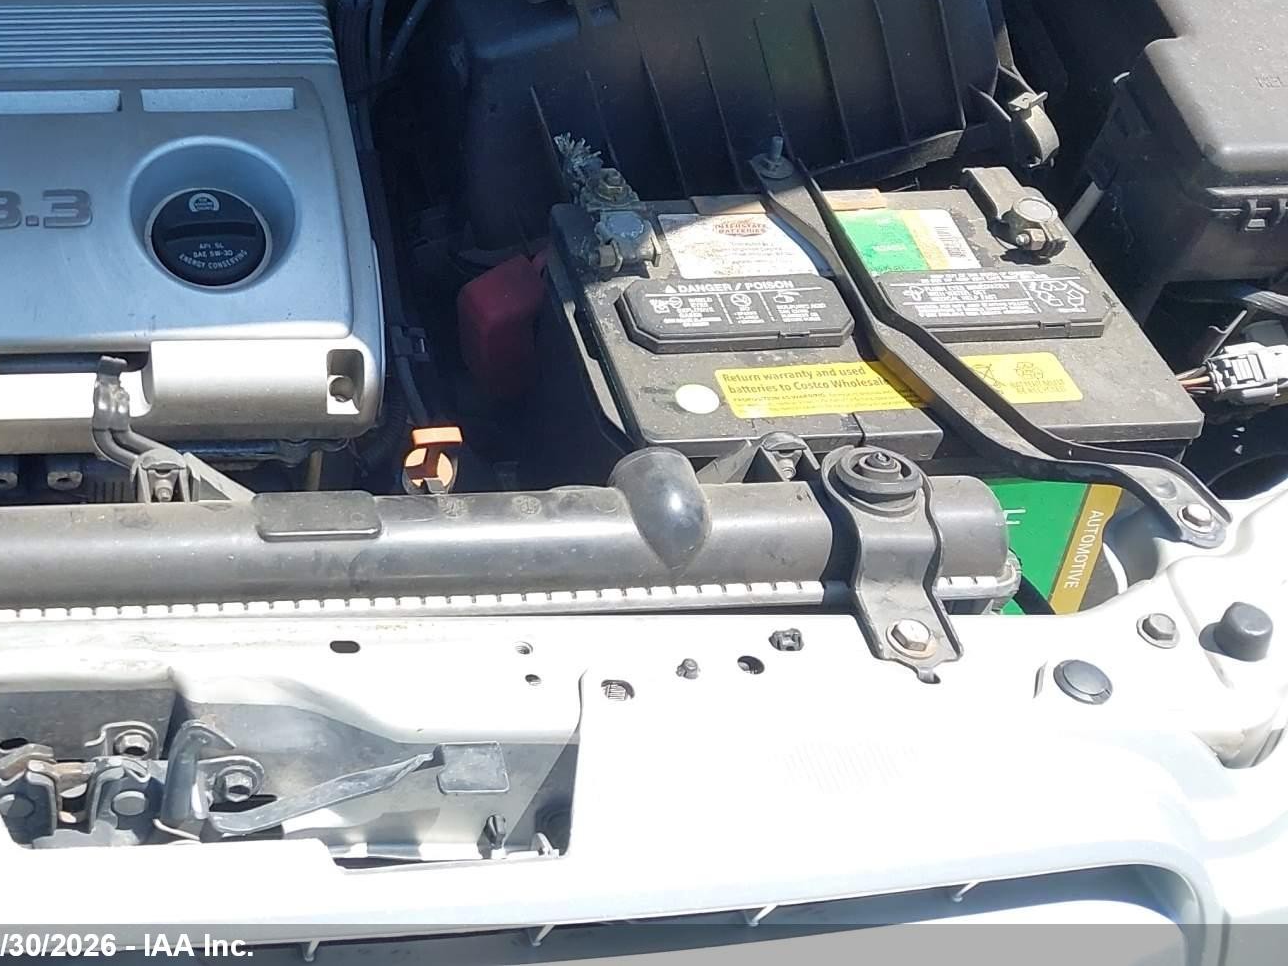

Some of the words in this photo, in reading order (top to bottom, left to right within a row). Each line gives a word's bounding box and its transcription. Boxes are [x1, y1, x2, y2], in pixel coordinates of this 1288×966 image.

[178, 253, 206, 269] ENERGY
[677, 283, 733, 293] DANGER
[744, 280, 794, 291] POISON
[721, 372, 762, 383] Return
[762, 369, 813, 381] warranty
[814, 367, 838, 378] and
[839, 366, 867, 376] used
[727, 384, 778, 394] batteries
[778, 383, 792, 392] to
[793, 380, 830, 391] Costco
[1063, 509, 1105, 590] AUTOMOTIVE
